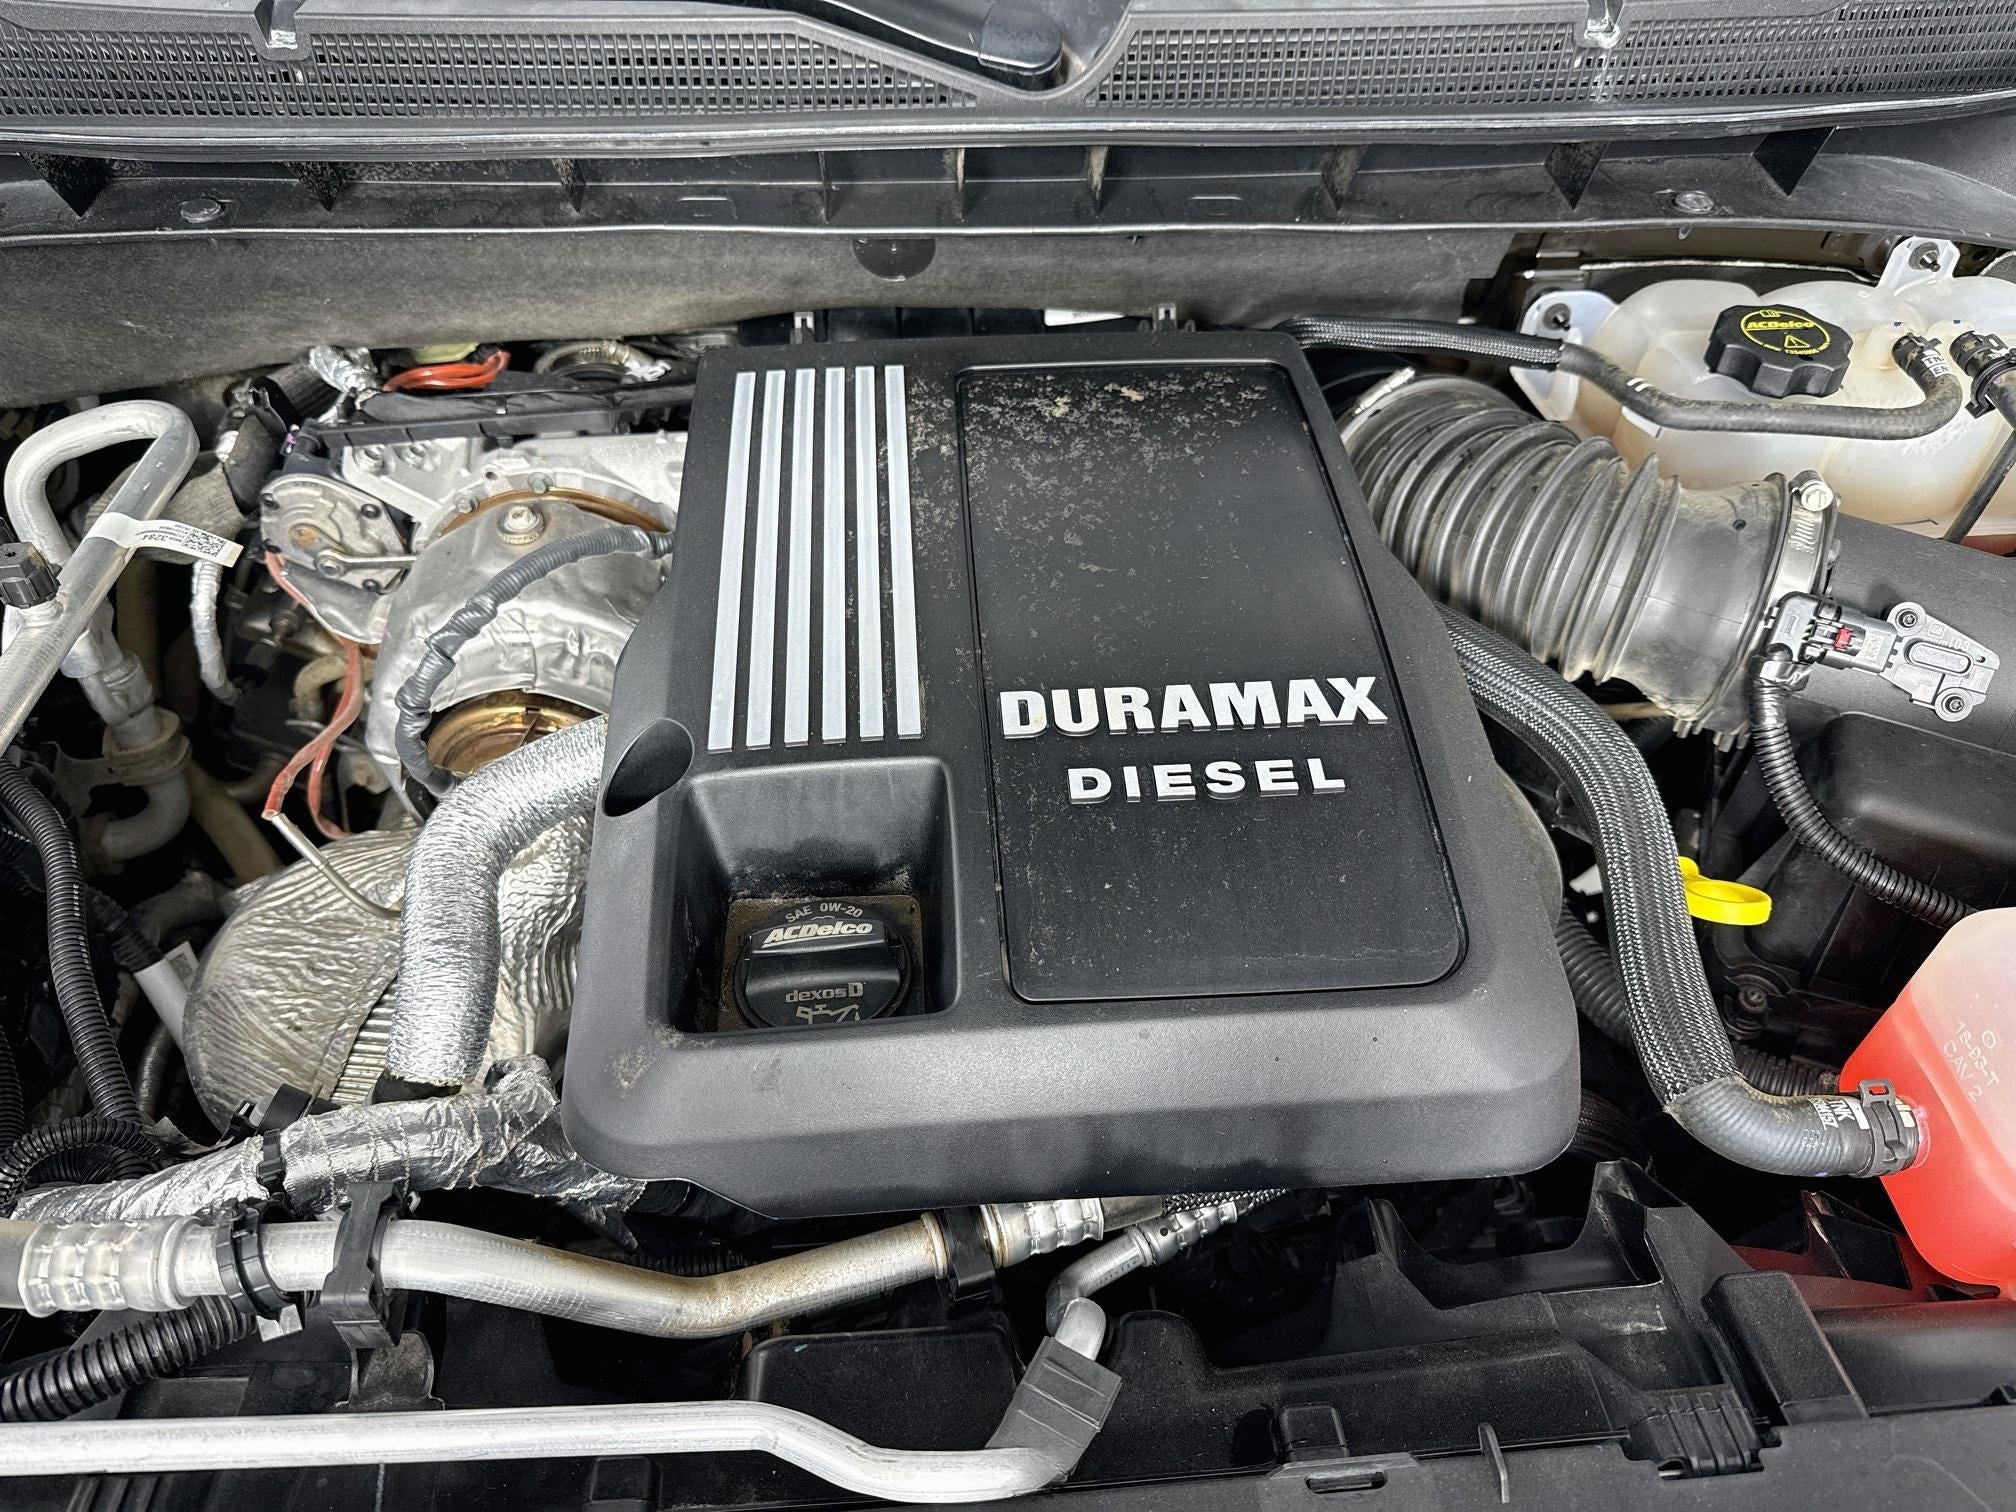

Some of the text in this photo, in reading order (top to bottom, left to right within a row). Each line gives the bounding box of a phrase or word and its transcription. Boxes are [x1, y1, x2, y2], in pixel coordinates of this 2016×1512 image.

[1747, 321, 1814, 329] ACDelco
[999, 676, 1388, 739] DURAMAX
[1066, 757, 1346, 804] DIESEL
[785, 902, 863, 923] SAE 0W-20
[763, 921, 873, 944] ACDelco
